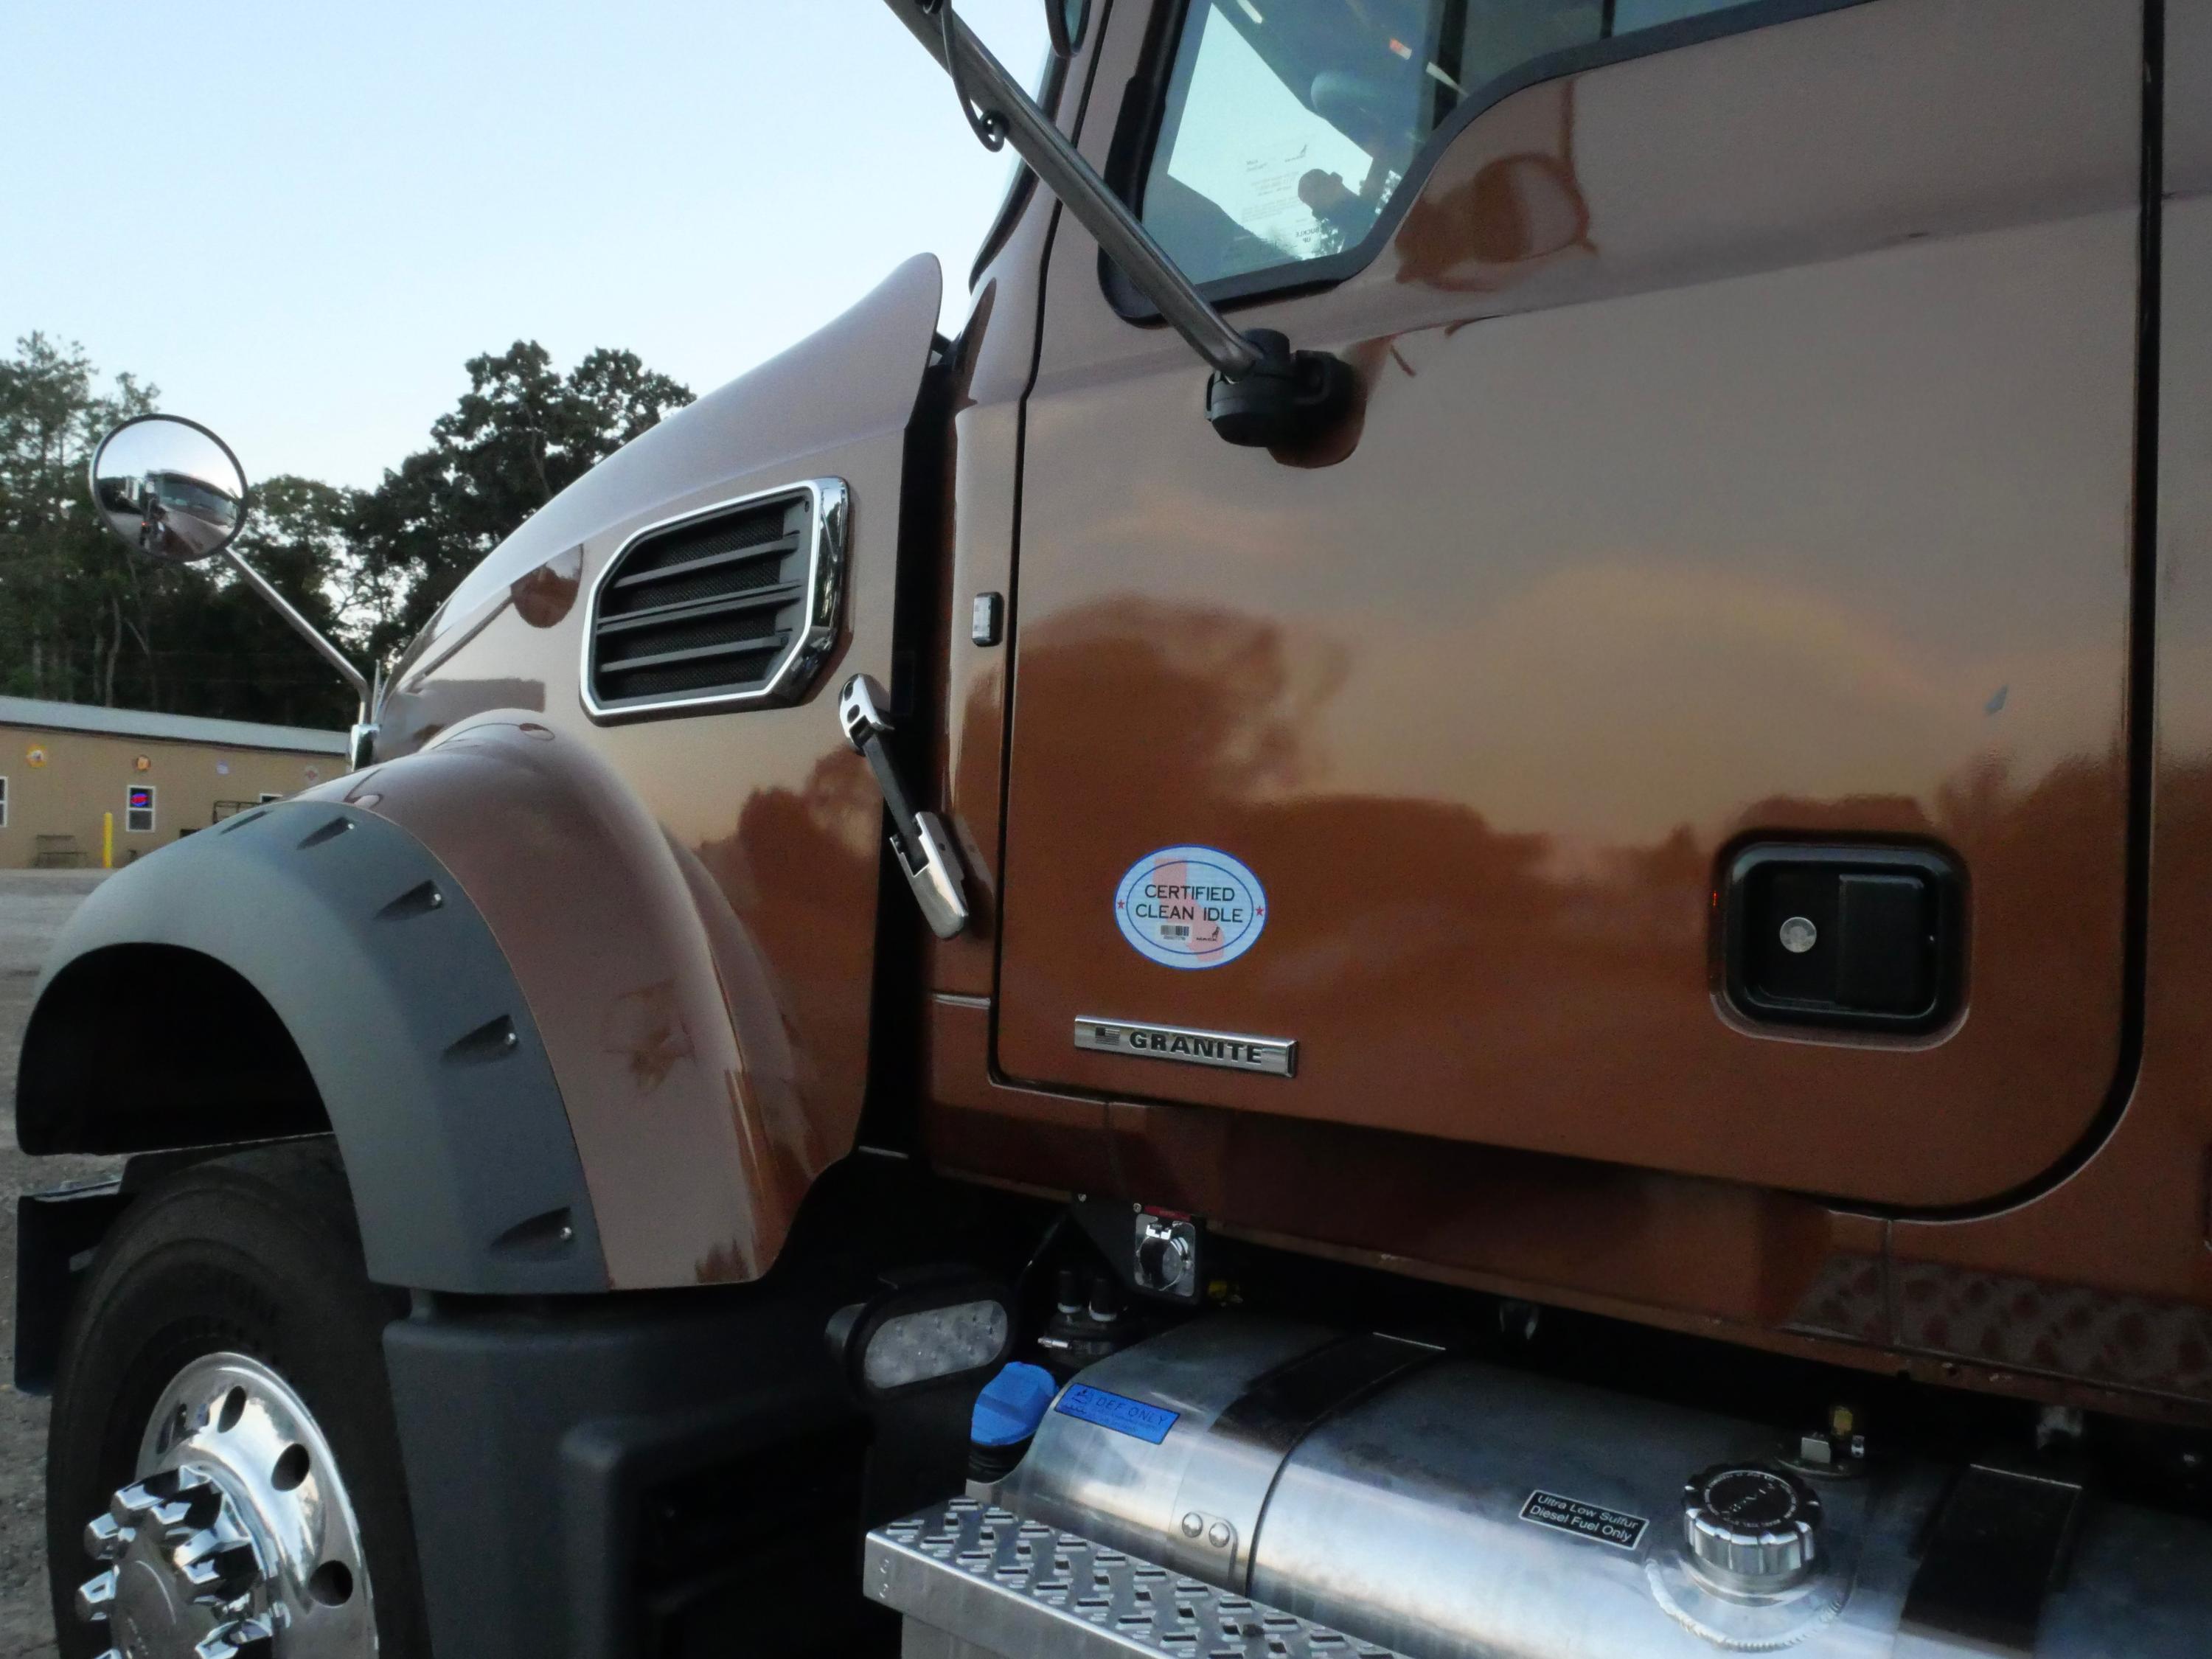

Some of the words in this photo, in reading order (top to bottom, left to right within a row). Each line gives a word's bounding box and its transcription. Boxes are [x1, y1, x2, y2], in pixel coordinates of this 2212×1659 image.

[1144, 884, 1235, 902] CERTIFIED
[1135, 904, 1194, 920] CLEAN
[1203, 908, 1243, 922] IDLE
[1130, 1032, 1262, 1063] GRANITE
[1096, 1398, 1125, 1411] DEF
[1128, 1407, 1168, 1425] ONLY
[1529, 1505, 1570, 1523] Diesel
[1571, 1516, 1600, 1531] Fuel
[1601, 1524, 1632, 1543] Only
[1537, 1495, 1567, 1510] Ultra
[1569, 1503, 1596, 1517] Low
[1599, 1512, 1638, 1529] Sulfur
